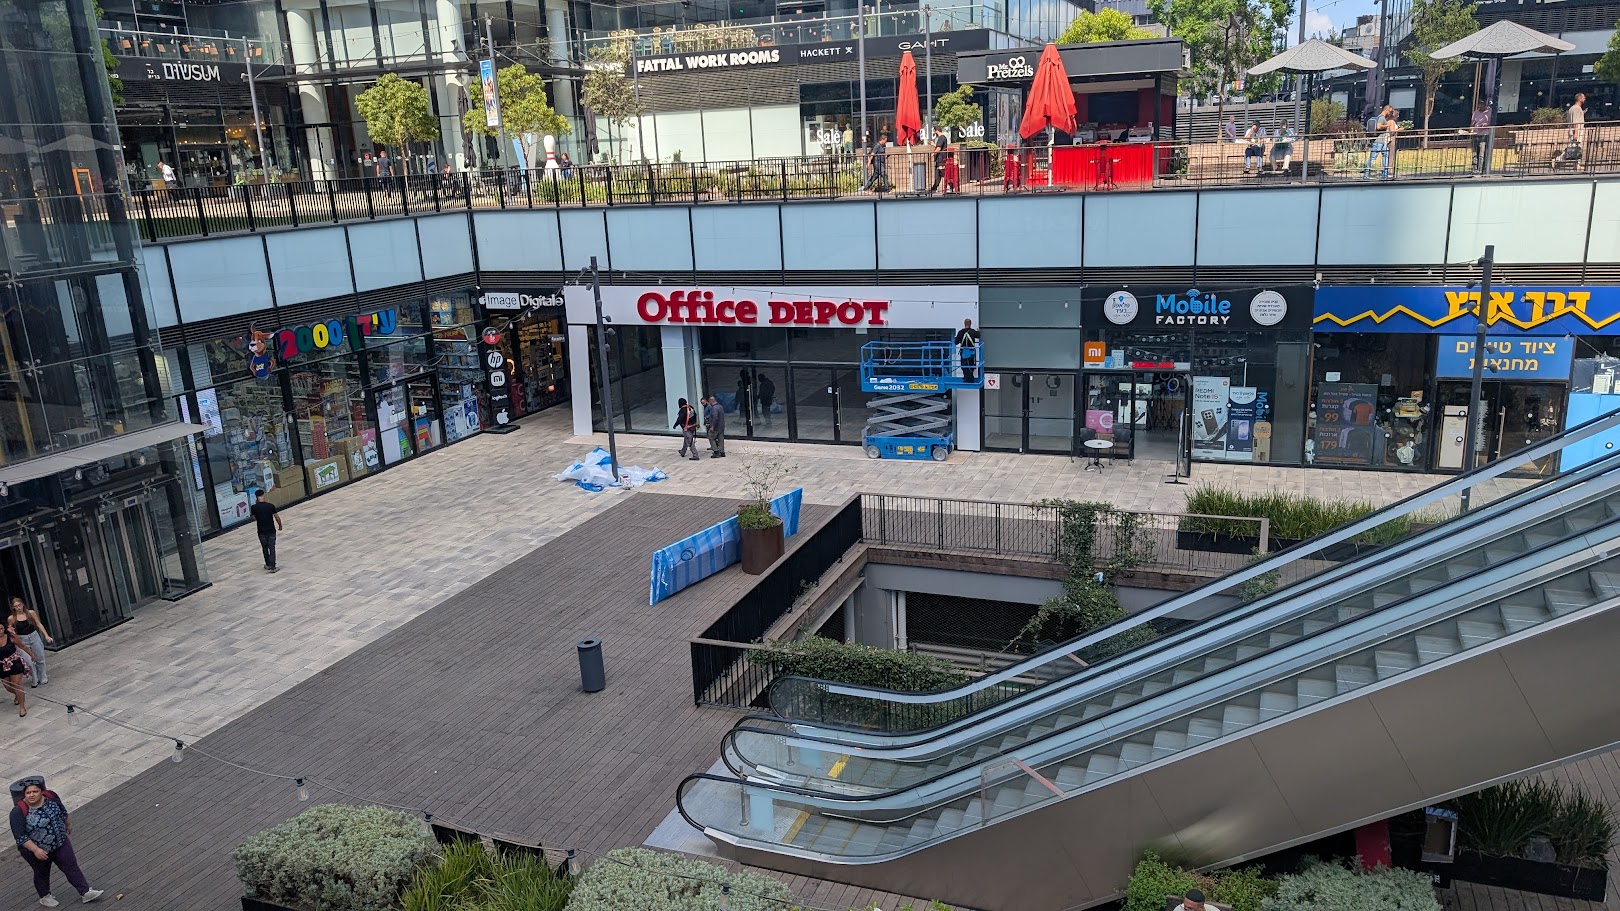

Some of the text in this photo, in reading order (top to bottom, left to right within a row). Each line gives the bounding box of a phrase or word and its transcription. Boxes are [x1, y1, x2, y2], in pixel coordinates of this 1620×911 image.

[800, 47, 841, 58] HACKETT
[637, 57, 684, 73] FATTAL
[685, 54, 729, 69] WORK
[730, 49, 780, 66] ROOMS
[816, 127, 841, 145] Sale
[487, 294, 517, 308] Image
[636, 290, 889, 325] Office DEPOT
[1156, 292, 1231, 315] Mobile
[1444, 291, 1591, 322] דרך ארץ
[1156, 315, 1230, 325] FACTORY
[277, 308, 396, 360] עידן 2000
[1519, 341, 1556, 354] ציוד
[490, 353, 501, 368] hp
[1324, 412, 1339, 422] 99
[1319, 440, 1338, 450] 179
